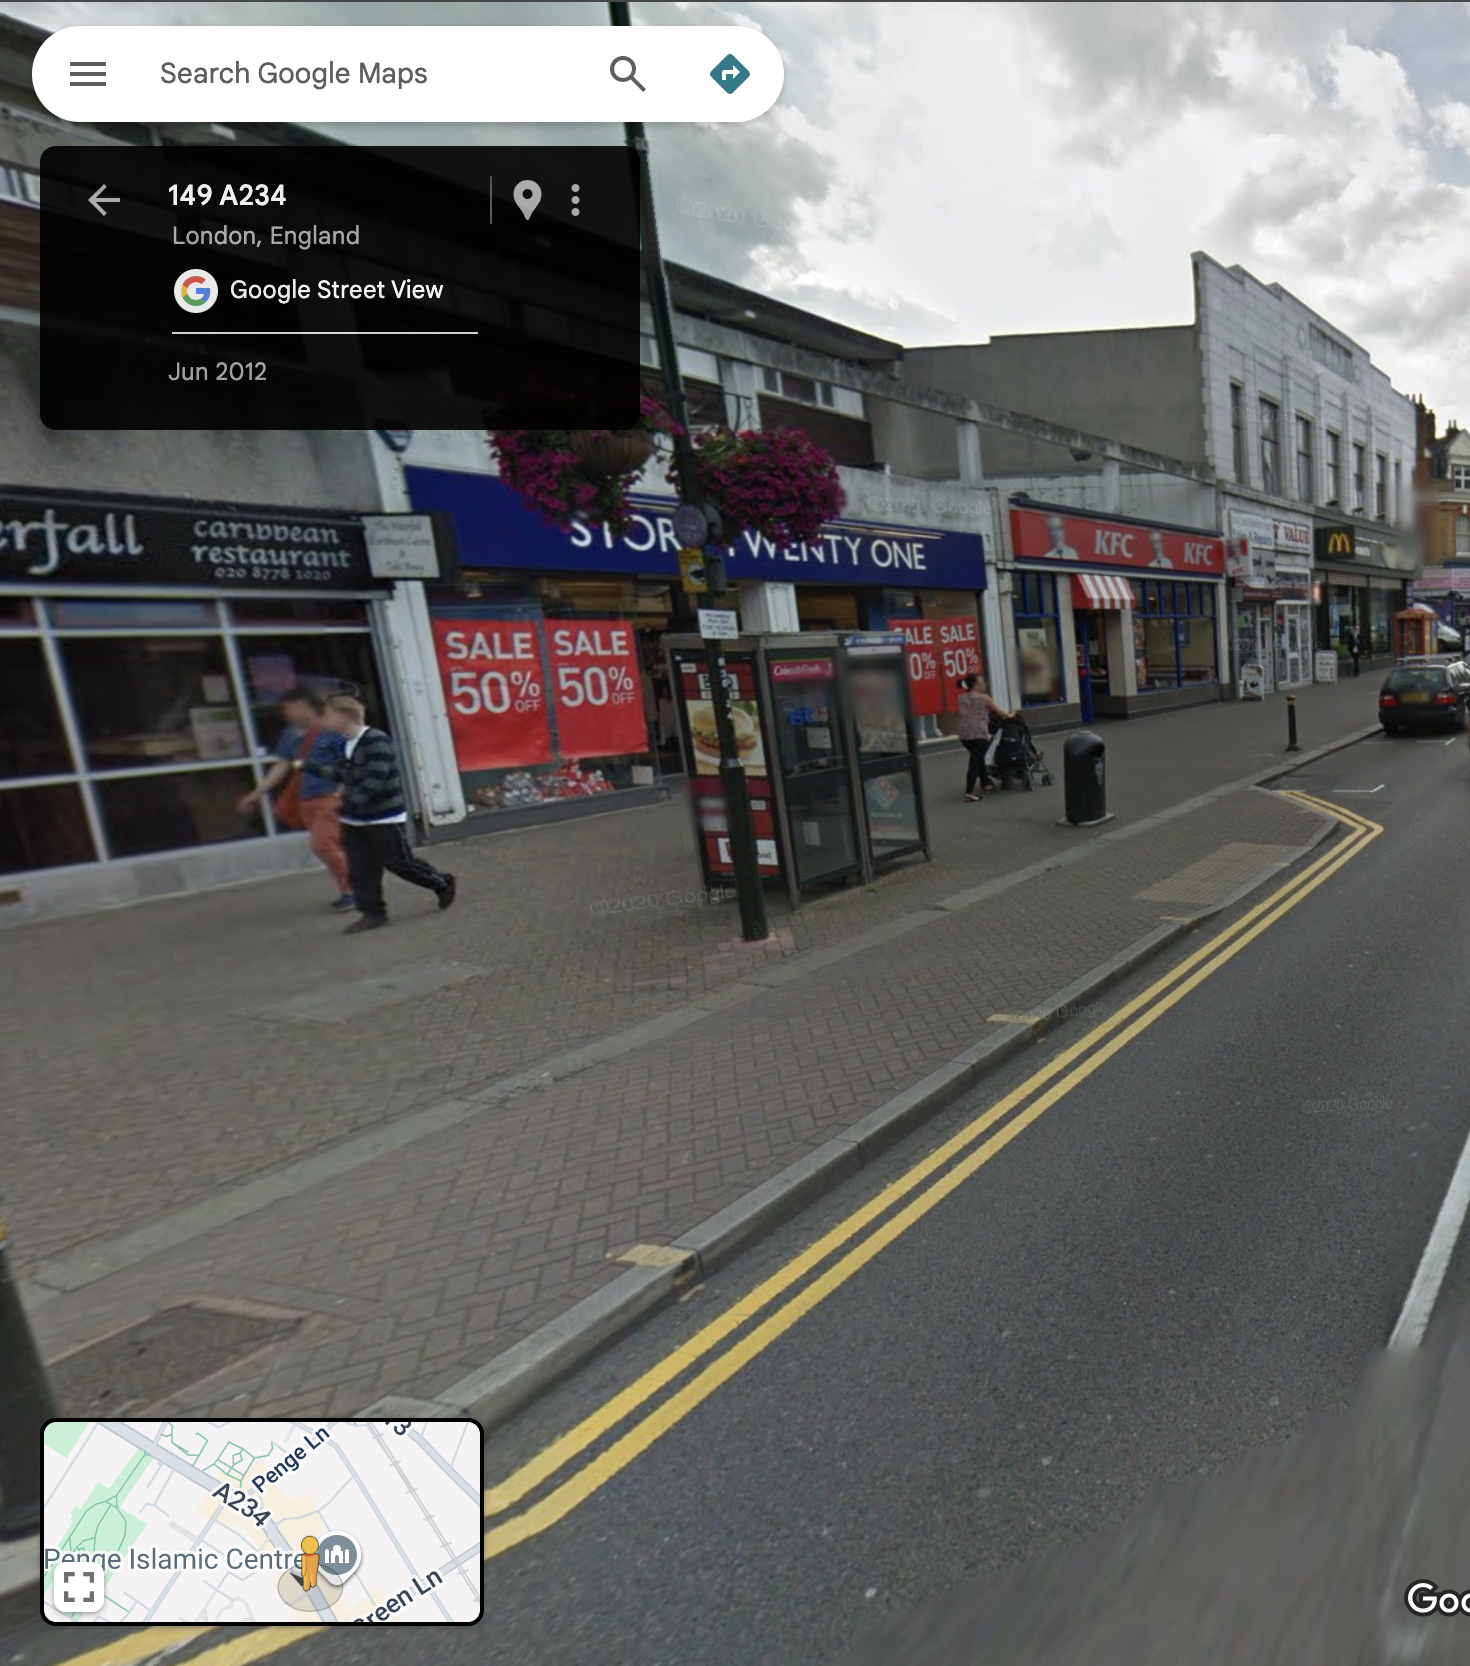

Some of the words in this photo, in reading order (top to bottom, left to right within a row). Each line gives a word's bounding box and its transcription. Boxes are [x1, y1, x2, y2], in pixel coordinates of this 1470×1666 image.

[570, 513, 683, 552] STOR
[728, 530, 863, 565] WENTY
[870, 539, 927, 570] ONE
[1094, 528, 1134, 559] KFC
[1283, 526, 1310, 545] VALUE
[190, 544, 352, 569] restaurant
[1183, 541, 1214, 566] KFC
[214, 567, 247, 579] 020
[252, 566, 290, 580] 8778
[296, 569, 333, 581] 1020
[446, 630, 535, 660] SALE
[554, 630, 629, 656] SALE
[940, 623, 976, 644] SALE
[908, 651, 937, 680] 0%
[924, 670, 937, 680] OFF
[943, 647, 979, 678] 50%
[451, 670, 540, 715] 50%
[558, 665, 634, 708] 50%
[612, 692, 635, 705] OFF
[514, 699, 541, 713] OFF
